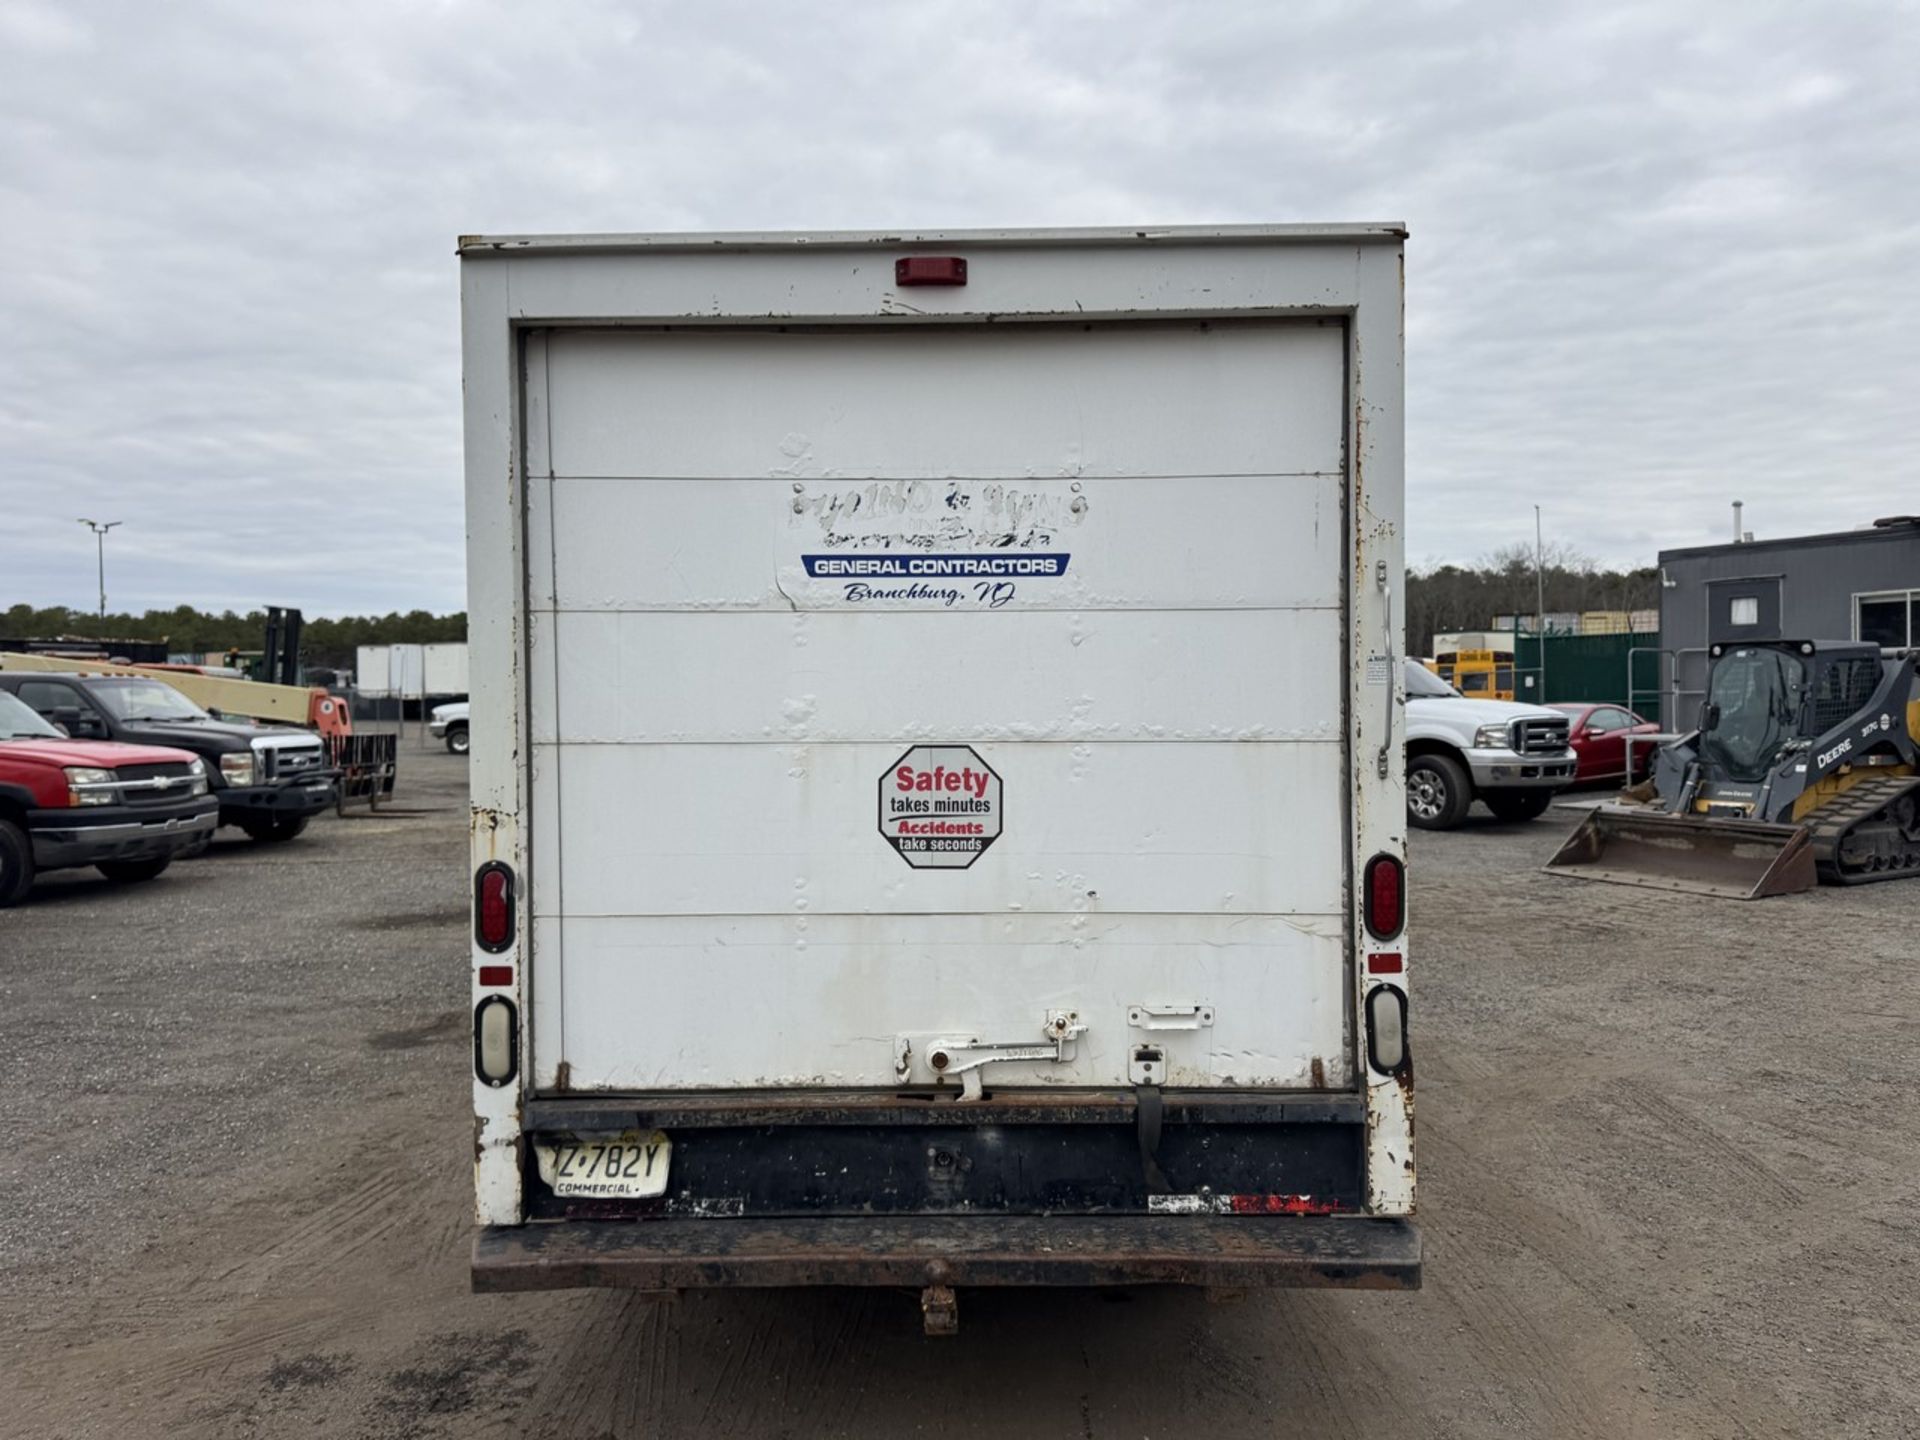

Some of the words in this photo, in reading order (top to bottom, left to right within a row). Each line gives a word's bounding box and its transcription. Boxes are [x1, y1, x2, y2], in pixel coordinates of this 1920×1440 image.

[814, 559, 907, 575] GENERAL
[908, 558, 1058, 575] CONTRACTORS
[973, 581, 1016, 608] NJ
[1817, 738, 1852, 769] DEERE
[896, 765, 989, 798] Safety
[890, 797, 930, 812] takes
[934, 797, 991, 812] minutes
[897, 820, 984, 834] Accidents
[899, 837, 927, 850] take
[930, 837, 982, 850] seconds
[557, 1183, 632, 1194] COMMERCIAL
